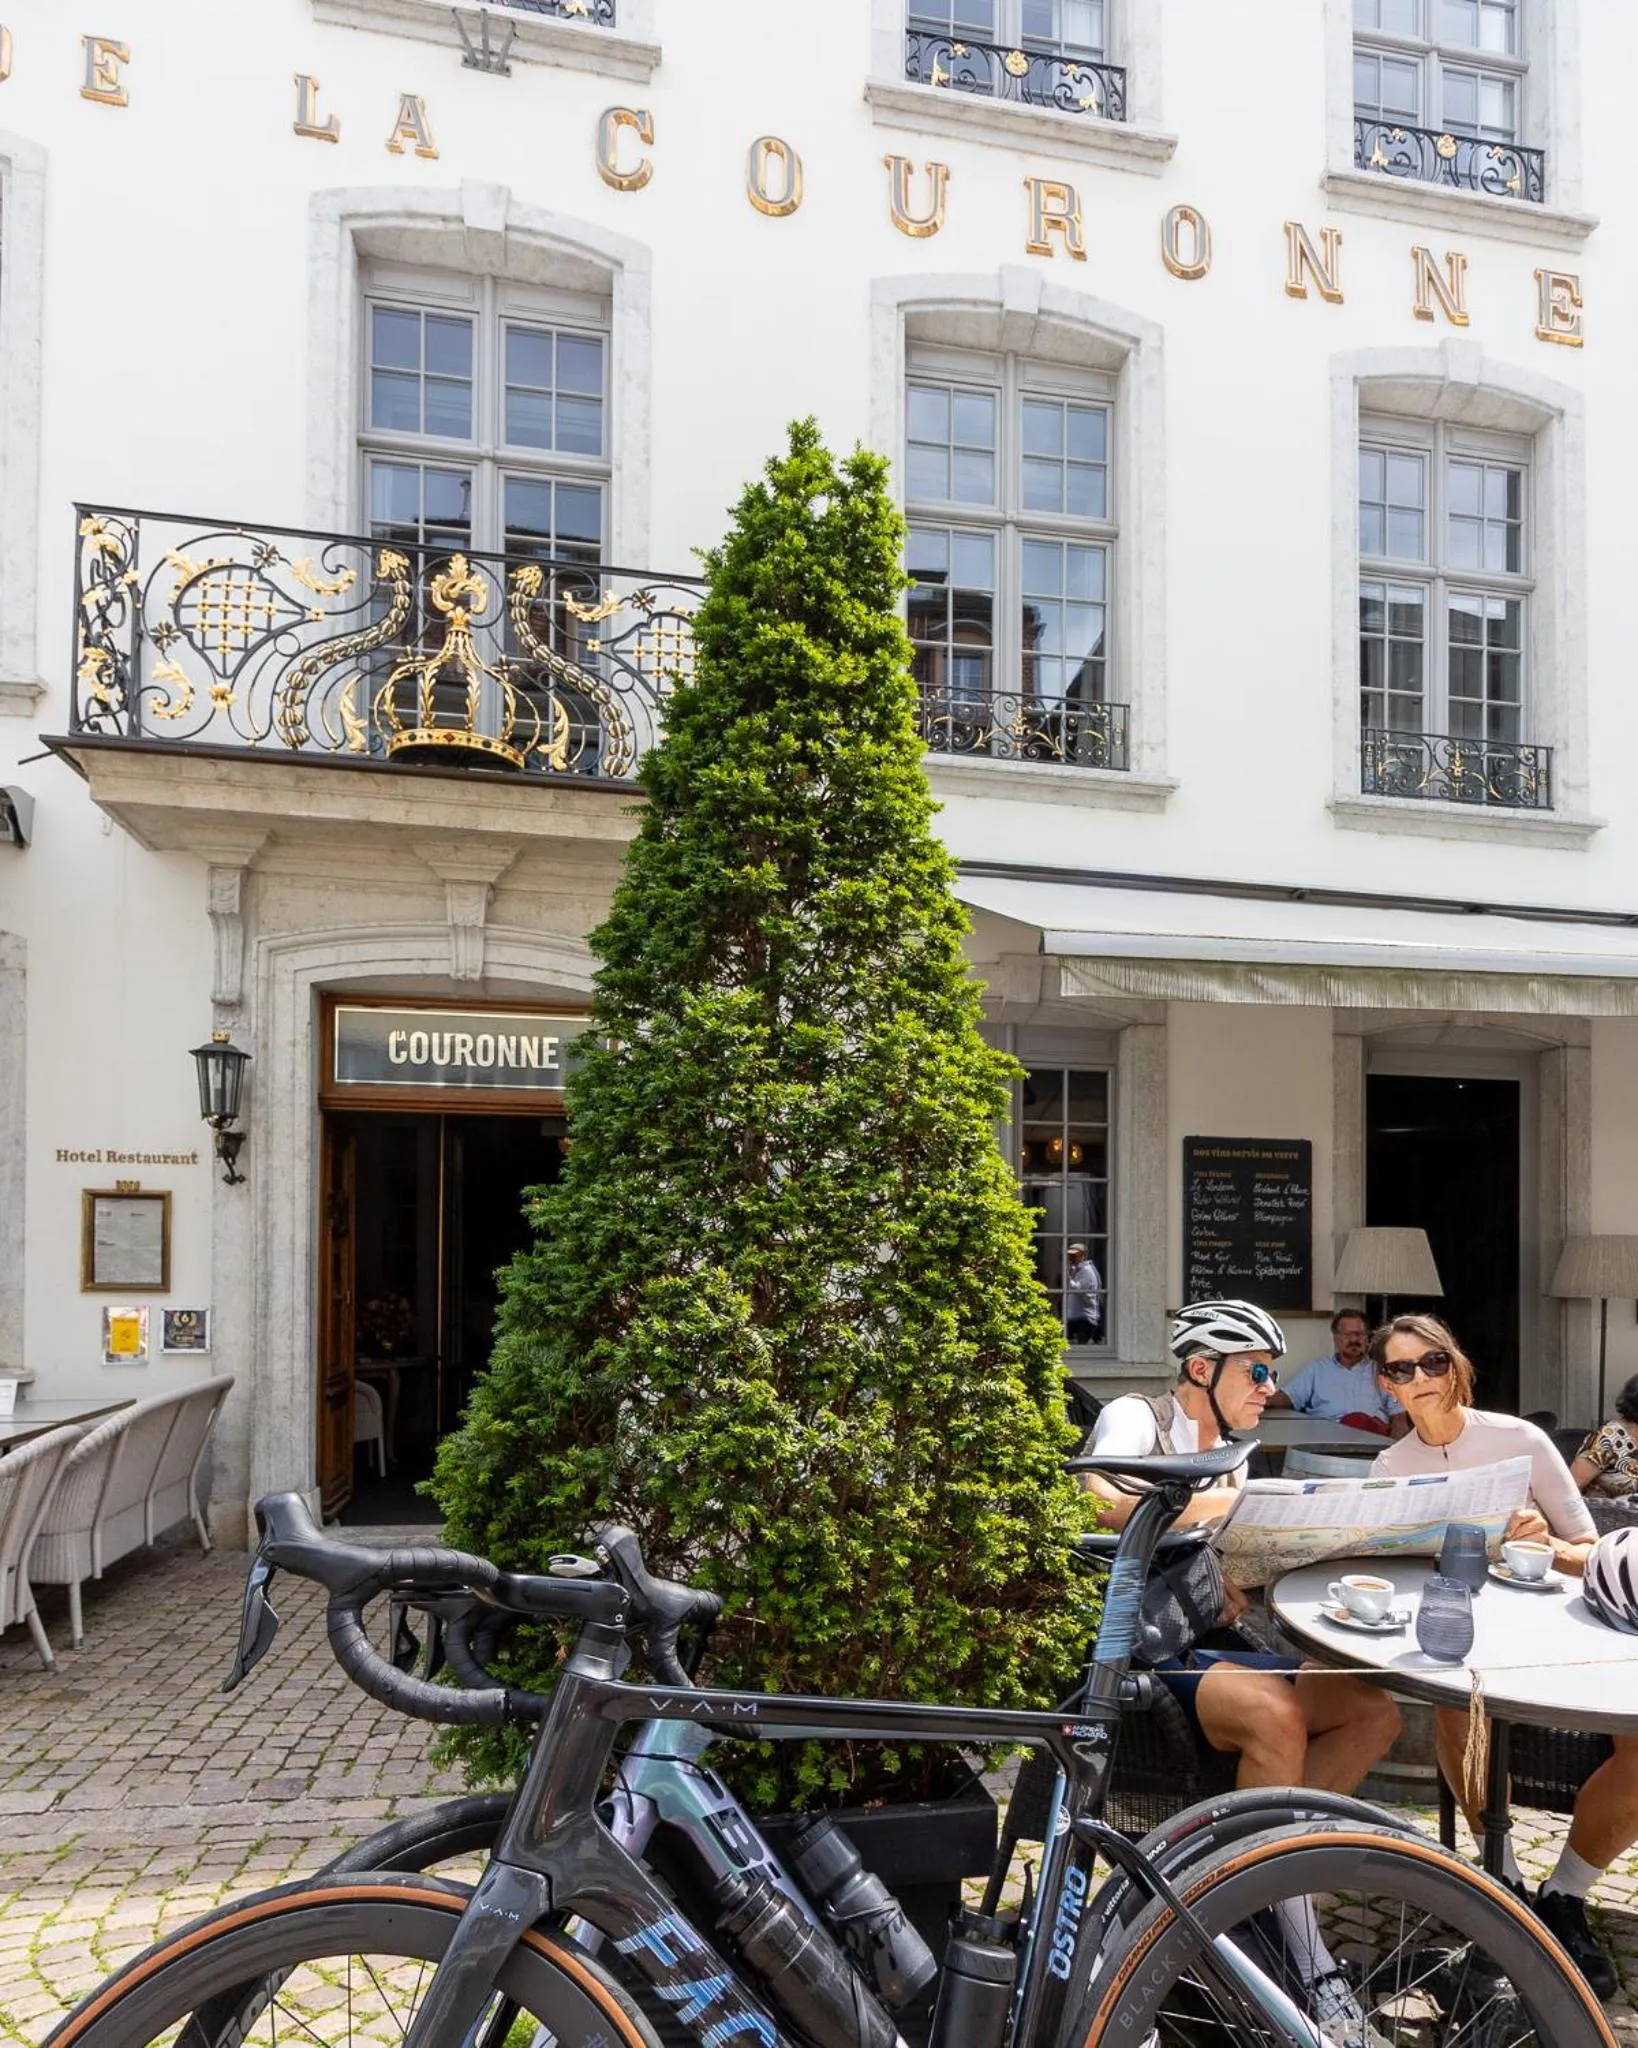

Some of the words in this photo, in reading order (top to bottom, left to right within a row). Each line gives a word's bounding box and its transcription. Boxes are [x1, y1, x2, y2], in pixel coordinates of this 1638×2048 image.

[0, 24, 131, 107] E
[292, 72, 440, 160] LA
[596, 104, 1584, 347] COURONNE
[388, 1030, 560, 1070] COURONNE
[55, 1149, 102, 1164] Hotel
[106, 1150, 199, 1166] Restaurant
[1046, 1864, 1087, 1981] OSTRO
[1119, 1952, 1178, 2032] BLACK
